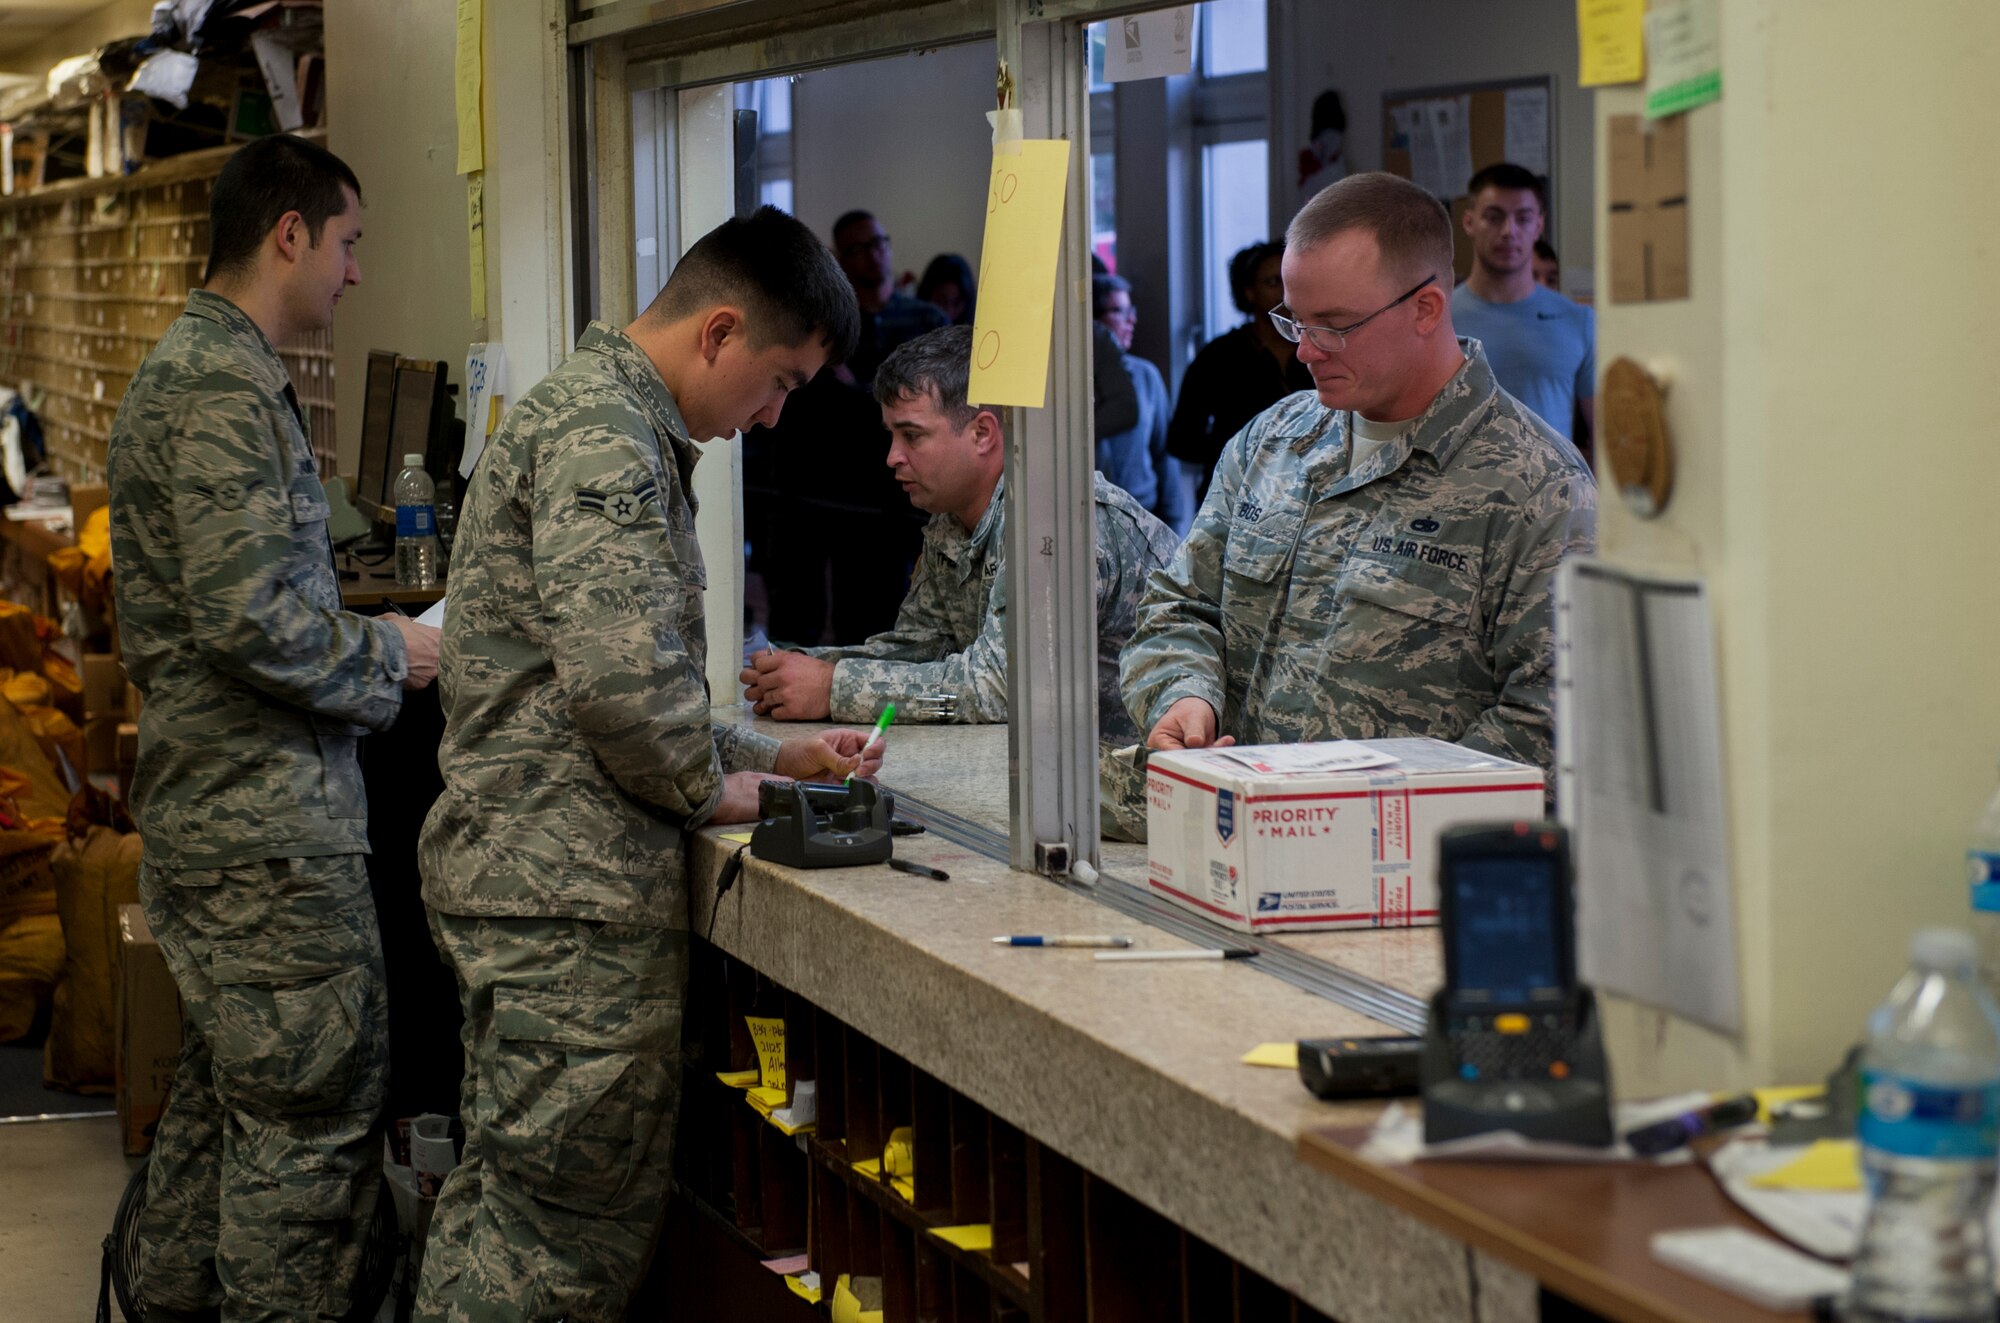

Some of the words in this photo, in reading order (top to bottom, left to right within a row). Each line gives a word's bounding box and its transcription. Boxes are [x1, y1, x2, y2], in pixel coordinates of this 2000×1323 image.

[1394, 540, 1418, 558] AIR
[1419, 544, 1468, 572] FORCE
[1146, 777, 1174, 798] PRIORITY
[1252, 807, 1338, 823] PRIORITY
[1386, 811, 1395, 836] MAIL
[1394, 799, 1403, 849] PRIORITY
[1270, 825, 1317, 838] MAIL
